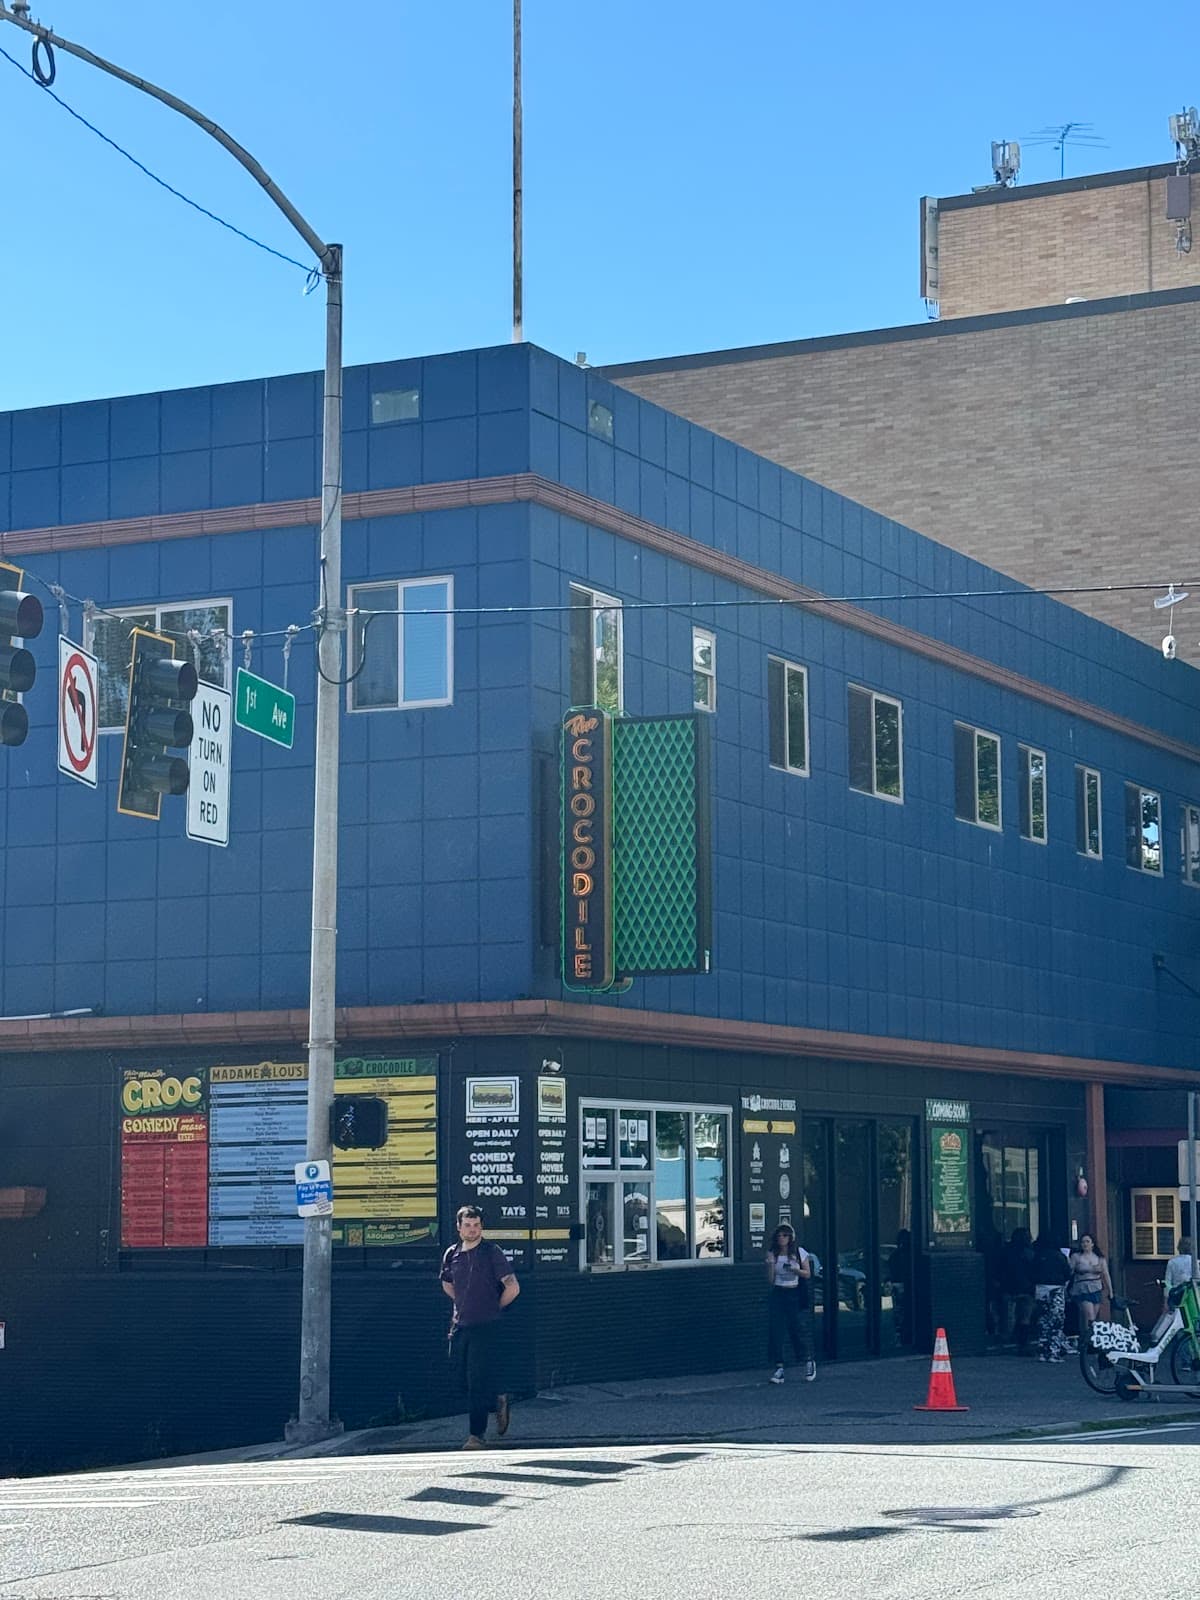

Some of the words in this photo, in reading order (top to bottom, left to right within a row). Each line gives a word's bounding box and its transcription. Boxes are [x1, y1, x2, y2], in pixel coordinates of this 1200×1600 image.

[246, 685, 257, 714] 1st
[271, 702, 288, 729] Ave
[202, 700, 221, 733] NO
[199, 737, 222, 764] TURN
[203, 770, 216, 794] ON
[200, 801, 218, 825] RED
[570, 738, 596, 978] CROCODILE
[212, 1067, 259, 1080] MADAME
[366, 1061, 414, 1075] CROCODILE
[122, 1077, 202, 1114] CROC
[122, 1117, 180, 1133] COMEDY
[465, 1129, 491, 1138] OPEN
[491, 1129, 520, 1138] DAILY
[469, 1152, 516, 1162] COMEDY
[540, 1152, 565, 1162] COMEDY
[309, 1167, 317, 1177] P
[471, 1163, 514, 1174] MOVIES
[541, 1163, 564, 1173] MOVIES
[462, 1174, 524, 1185] COCKTAILS
[536, 1174, 569, 1185] COCKTAILS
[477, 1186, 509, 1196] FOOD
[544, 1186, 561, 1196] FOOD
